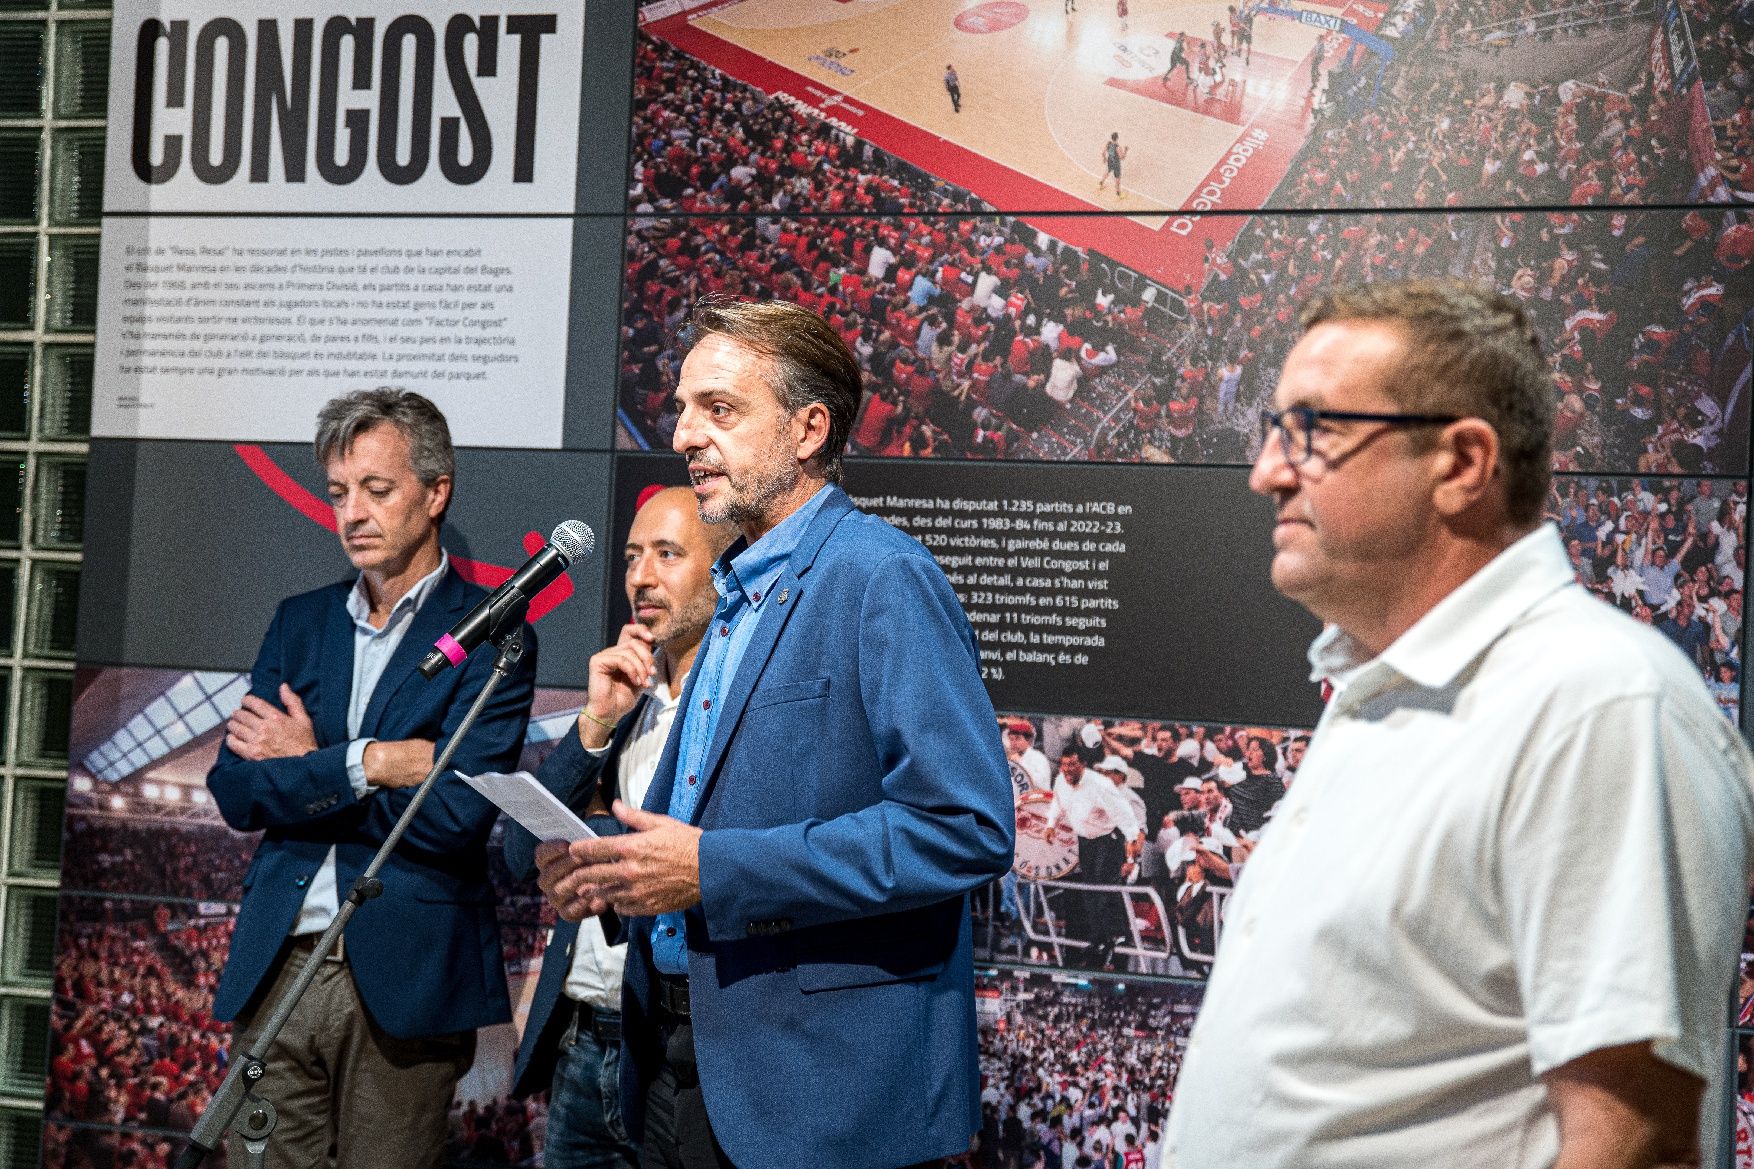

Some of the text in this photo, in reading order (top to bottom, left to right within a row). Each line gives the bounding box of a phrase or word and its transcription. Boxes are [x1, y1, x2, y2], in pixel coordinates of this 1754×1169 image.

[1304, 12, 1338, 30] BAXI
[132, 14, 557, 185] CONGOST
[886, 496, 934, 509] Manresa
[936, 498, 949, 509] ha
[952, 498, 998, 512] disputat
[1002, 499, 1034, 512] 1.235
[1036, 501, 1073, 514] partits
[1075, 503, 1083, 514] a
[1086, 501, 1115, 515] l'ACB
[1118, 505, 1132, 515] en
[912, 516, 932, 527] des
[934, 516, 952, 527] del
[954, 519, 978, 528] curs
[982, 517, 1030, 530] 1983-84
[1032, 518, 1054, 531] fins
[1056, 520, 1068, 532] al
[1070, 520, 1124, 534] 2022-23.
[925, 534, 947, 546] 520
[950, 535, 999, 549] victòries,
[1002, 537, 1006, 547] i
[1008, 537, 1050, 552] gairebé
[1052, 538, 1080, 551] dues
[1082, 540, 1097, 552] de
[1098, 540, 1126, 553] cada
[974, 556, 1005, 567] entre
[1008, 556, 1018, 567] el
[1020, 556, 1042, 568] Vell
[1043, 556, 1090, 573] Congost
[1092, 559, 1096, 570] i
[1098, 559, 1108, 571] el
[966, 573, 978, 584] al
[980, 573, 1014, 587] detall,
[1016, 577, 1024, 586] a
[1026, 577, 1052, 587] casa
[1054, 576, 1084, 589] s'han
[1088, 578, 1108, 590] vist
[970, 592, 992, 604] 323
[995, 593, 1037, 606] triomfs
[1038, 596, 1053, 606] en
[1056, 595, 1078, 607] 615
[1081, 597, 1118, 610] partits
[1006, 612, 1018, 623] 11
[1020, 613, 1062, 626] triomfs
[1065, 616, 1106, 630] seguits
[981, 630, 998, 641] del
[1000, 631, 1027, 644] club,
[1029, 632, 1040, 643] la
[1042, 633, 1105, 647] temporada
[1006, 650, 1016, 661] el
[1019, 650, 1056, 665] balanç
[1058, 652, 1072, 664] és
[1074, 653, 1088, 665] de
